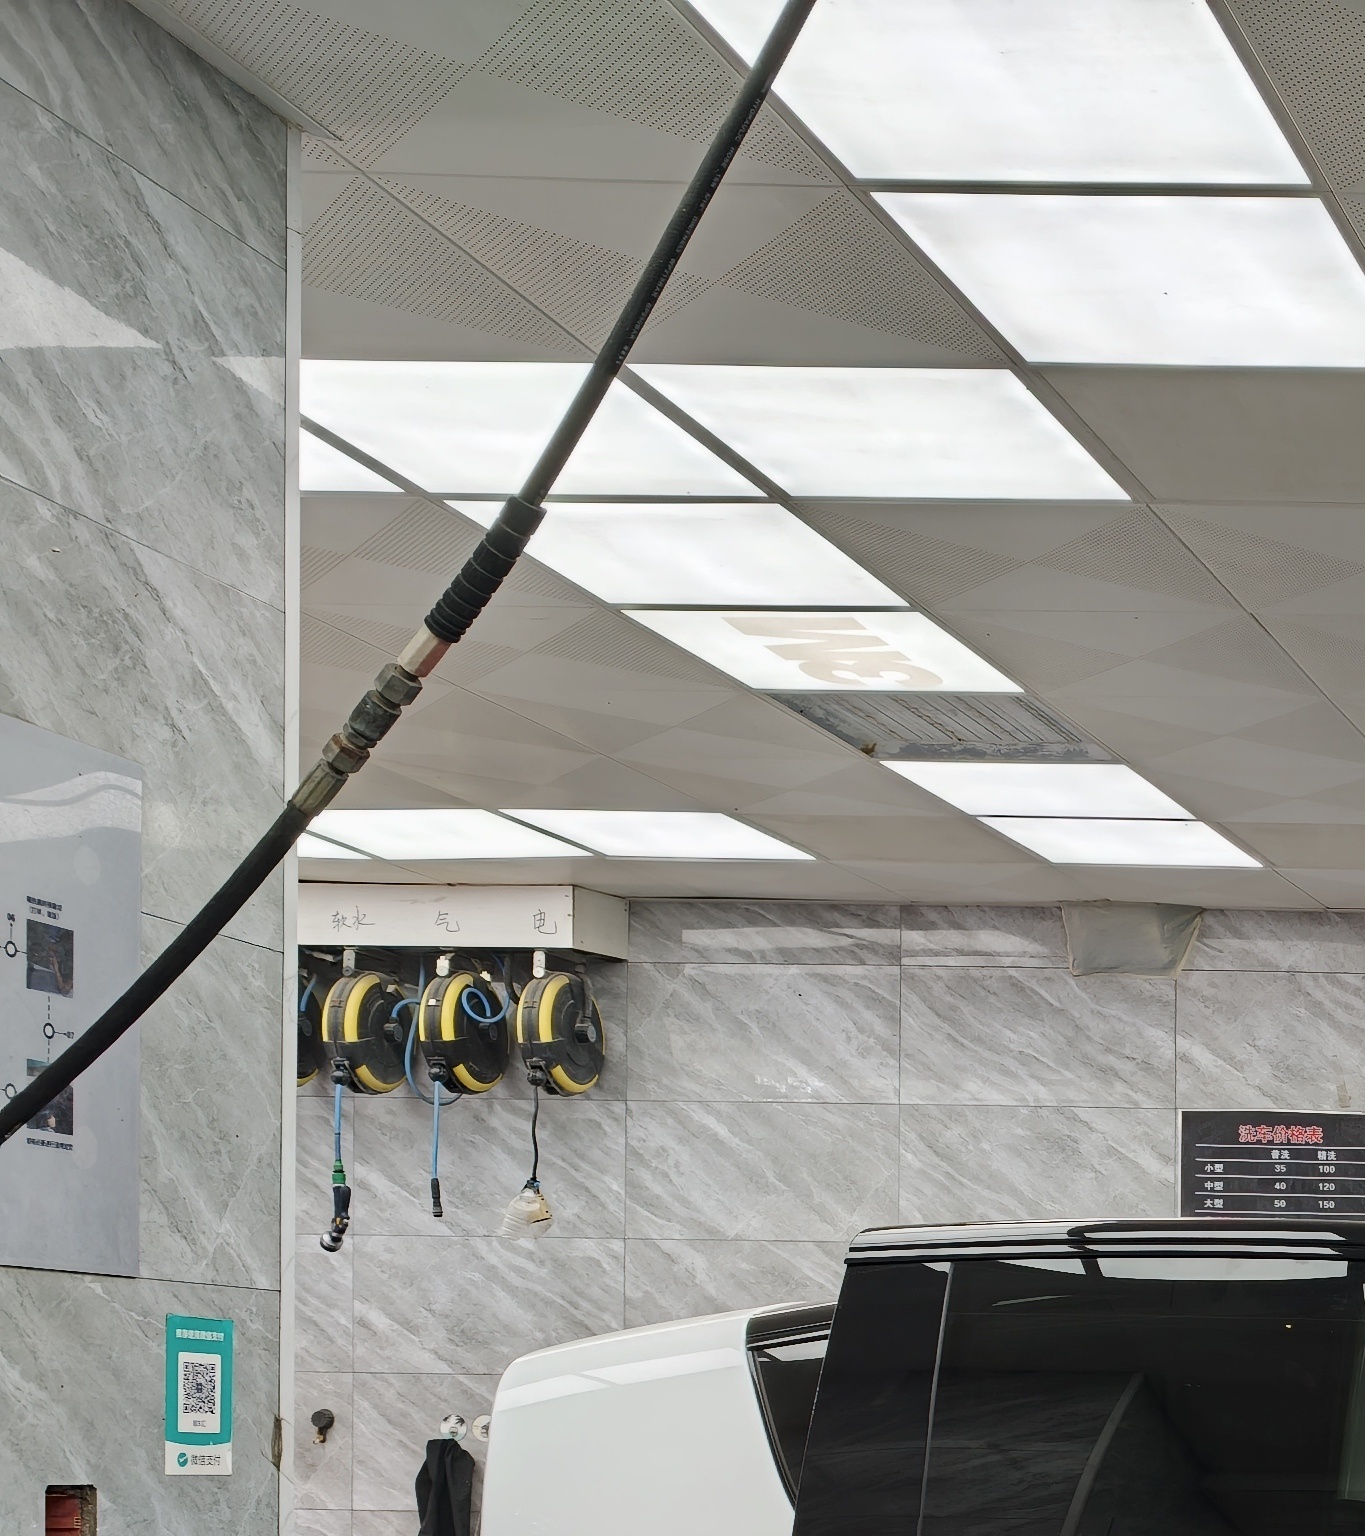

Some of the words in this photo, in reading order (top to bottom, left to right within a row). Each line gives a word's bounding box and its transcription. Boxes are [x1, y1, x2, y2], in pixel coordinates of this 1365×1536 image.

[435, 910, 460, 933] 气
[533, 908, 557, 935] 电
[1238, 1124, 1323, 1144] 洗车价格表
[1271, 1150, 1290, 1160] 普洗
[1317, 1150, 1337, 1161] 精洗
[1204, 1163, 1224, 1173] 小型
[1274, 1164, 1286, 1173] 35
[1318, 1165, 1335, 1173] 100
[1204, 1181, 1224, 1191] 中型
[1274, 1182, 1286, 1190] 40
[1318, 1183, 1335, 1191] 120
[1203, 1199, 1224, 1209] 大型
[1274, 1200, 1286, 1208] 50
[1318, 1201, 1335, 1209] 150
